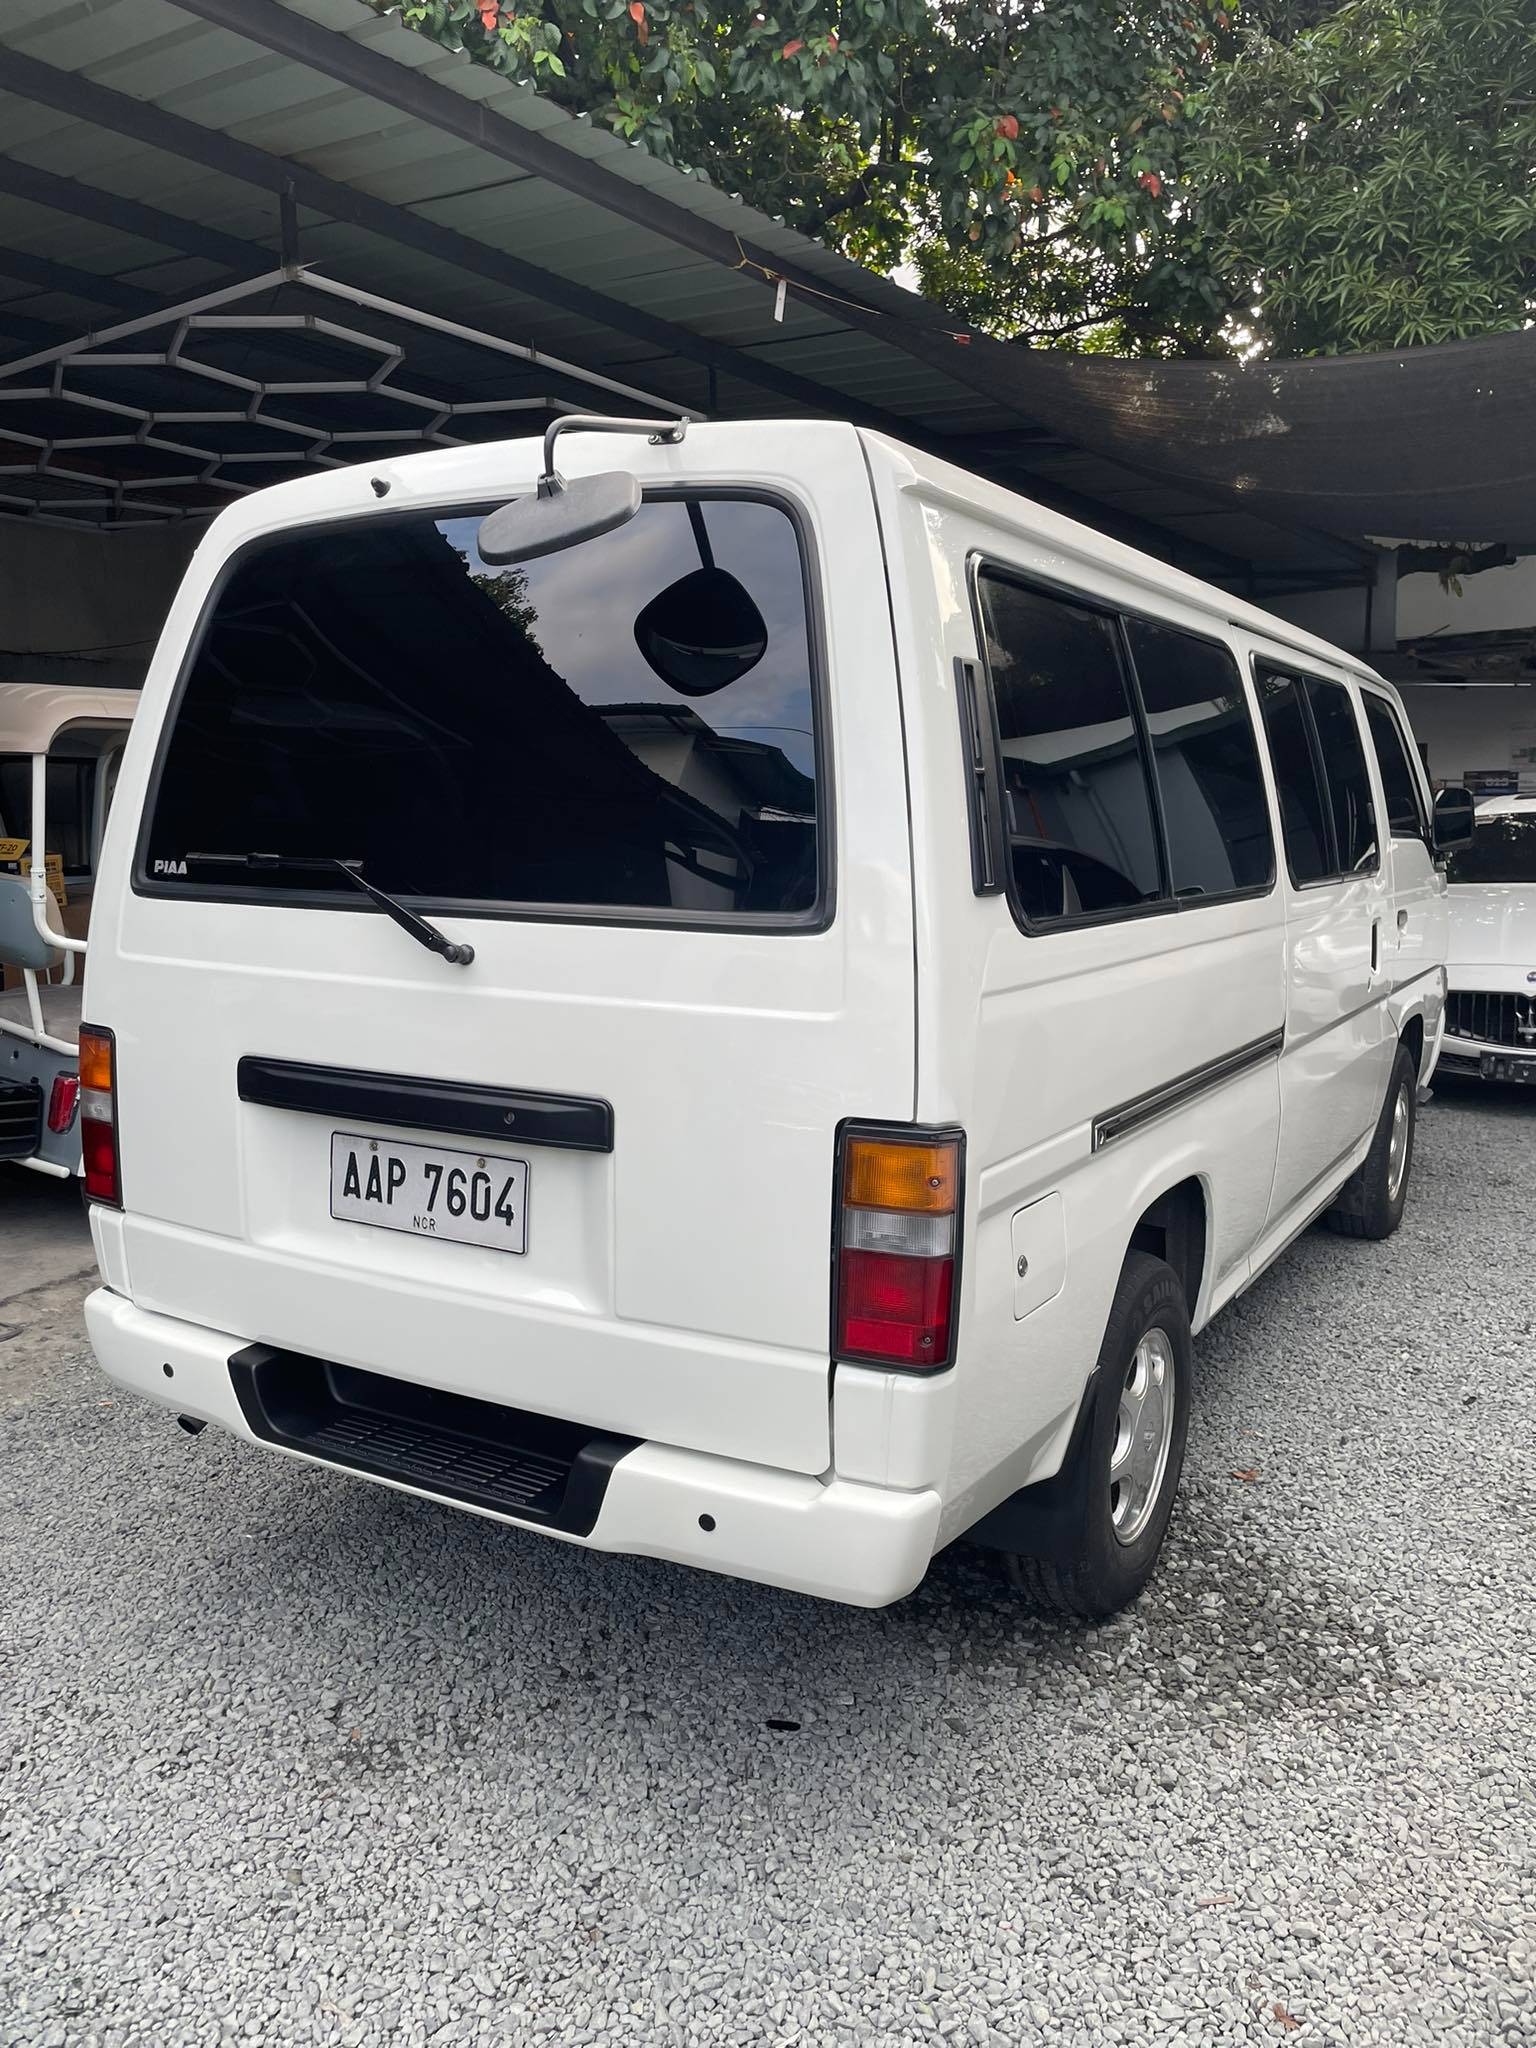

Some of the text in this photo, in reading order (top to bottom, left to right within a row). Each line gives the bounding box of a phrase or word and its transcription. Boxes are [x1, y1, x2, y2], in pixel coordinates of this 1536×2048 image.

[0, 843, 18, 852] F-20
[154, 860, 188, 875] PIAA
[343, 1151, 515, 1226] AAP 7604
[413, 1215, 436, 1231] NCR
